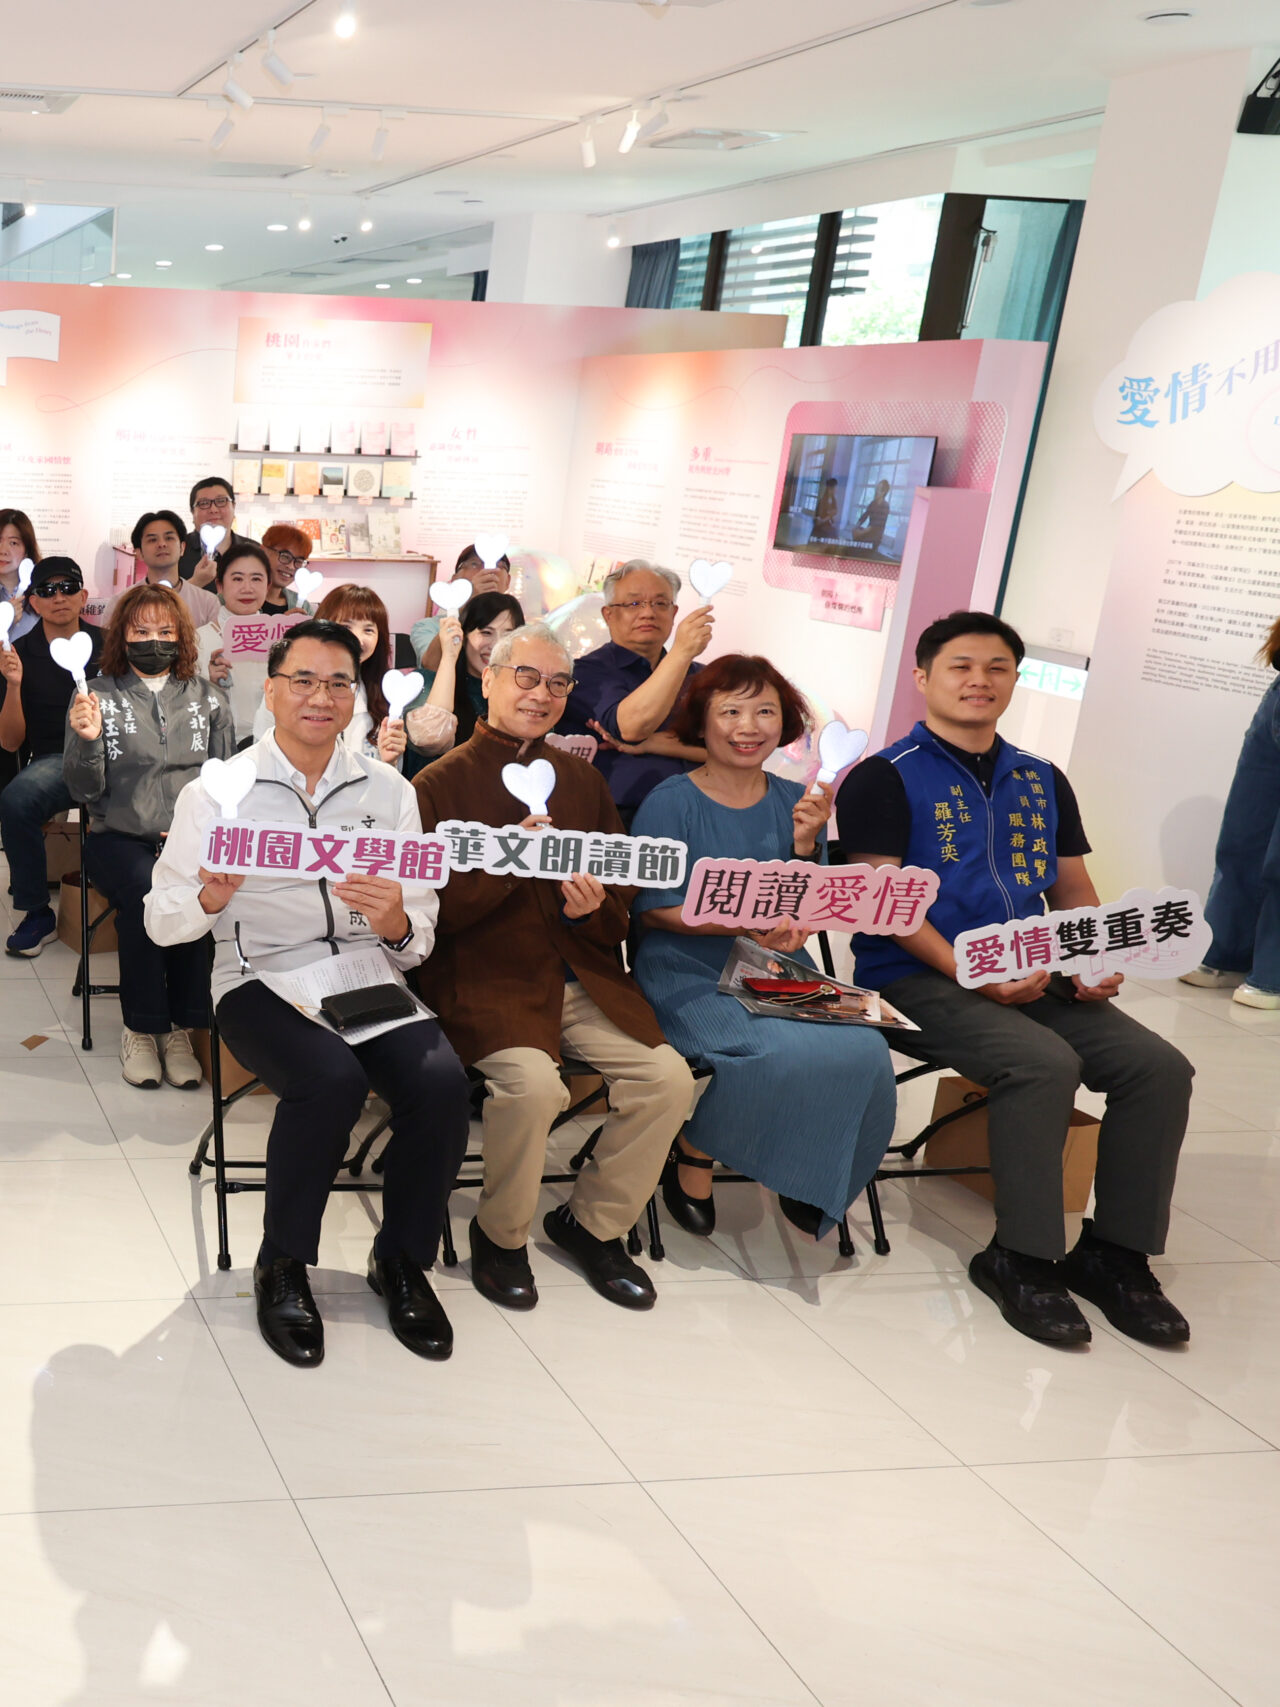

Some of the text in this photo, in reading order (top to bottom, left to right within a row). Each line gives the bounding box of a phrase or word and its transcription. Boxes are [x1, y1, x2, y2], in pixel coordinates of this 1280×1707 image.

[99, 698, 123, 760] 林玉芬
[187, 702, 206, 752] 于北辰
[934, 802, 961, 862] 羅芳奕
[950, 785, 972, 823] 副主任
[207, 825, 447, 882] 桃園文學館
[443, 823, 682, 883] 華文朗讀節
[693, 868, 929, 927] 閱讀愛情
[964, 899, 1196, 979] 愛情雙重奏
